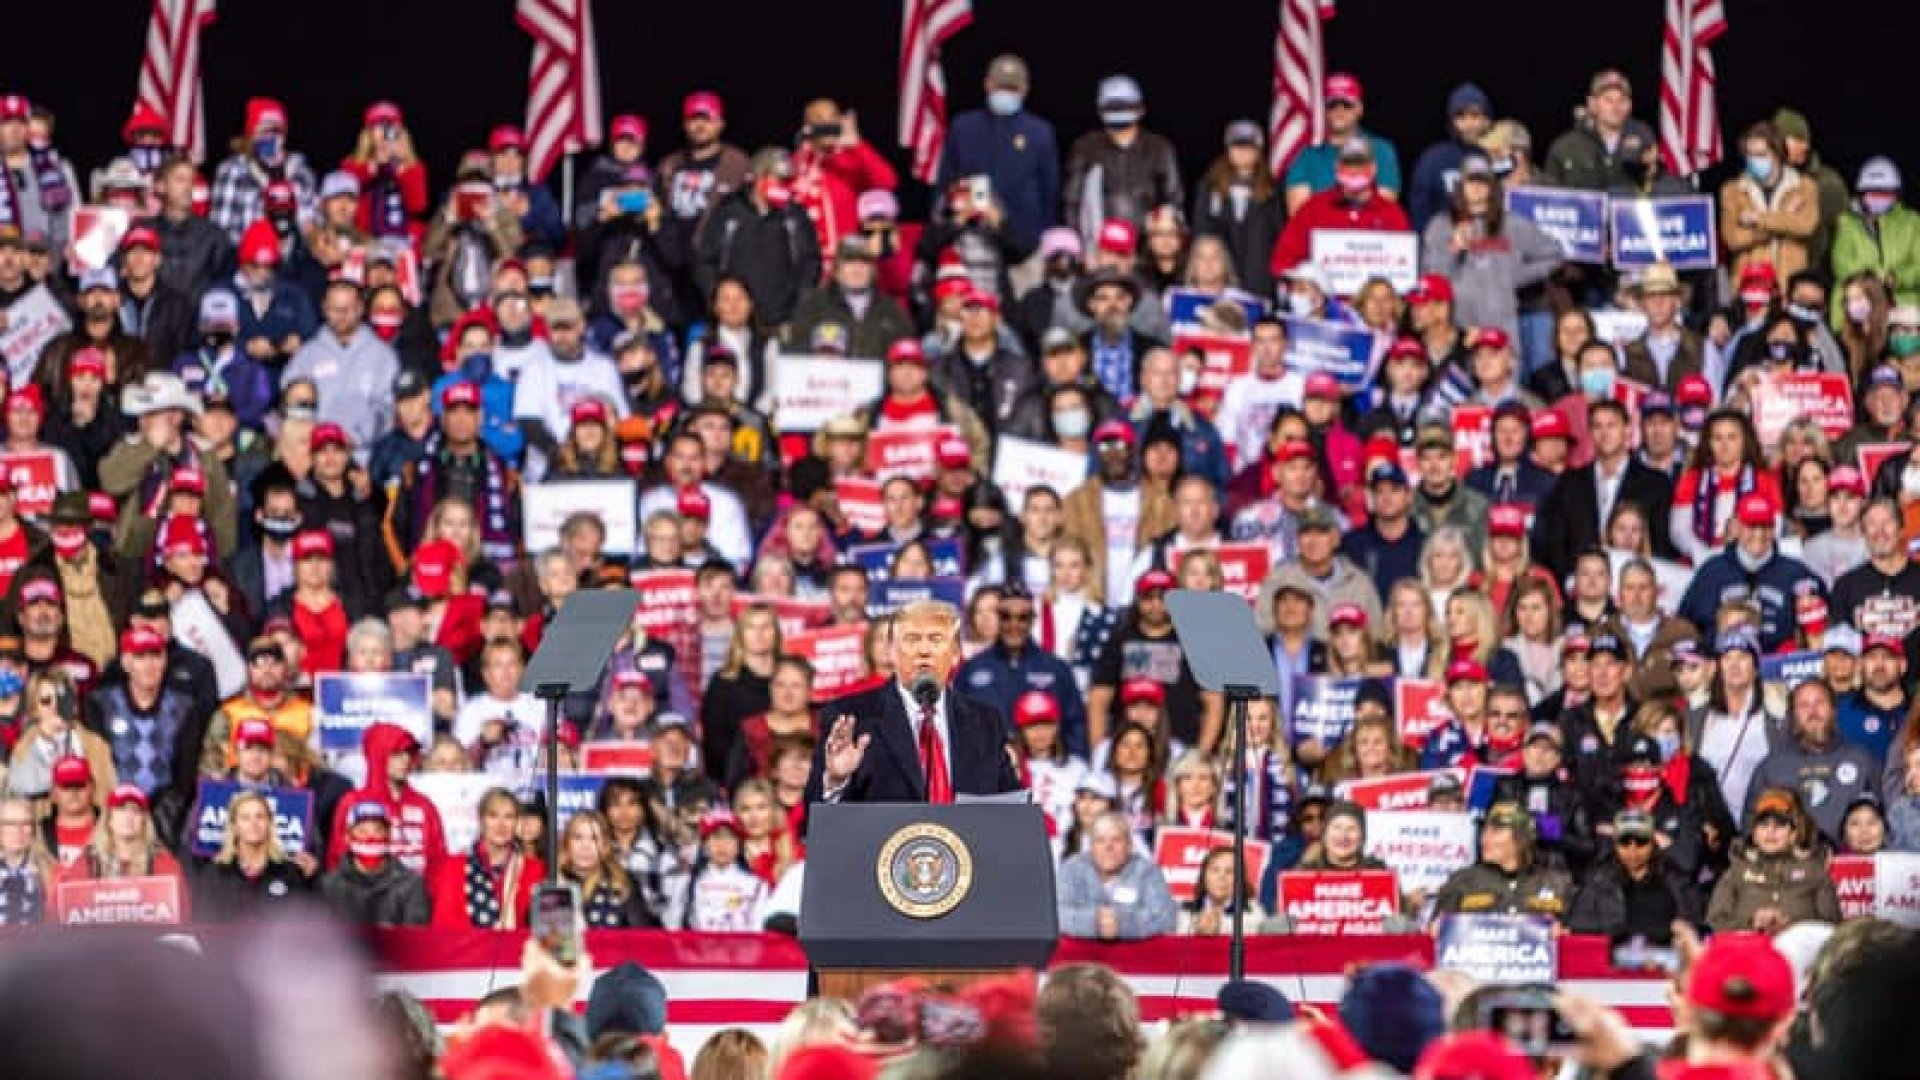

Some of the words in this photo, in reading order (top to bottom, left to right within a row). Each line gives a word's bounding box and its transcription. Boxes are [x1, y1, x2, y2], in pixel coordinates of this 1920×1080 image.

[1401, 826, 1441, 838] MAKE
[1370, 843, 1470, 860] AMERICA
[1314, 883, 1362, 898] MAKE
[1837, 879, 1874, 896] AVE
[69, 902, 173, 922] AMERICA
[1287, 899, 1394, 919] AMERICA
[1471, 927, 1518, 942] MAKE
[1443, 943, 1551, 965] AMERICA
